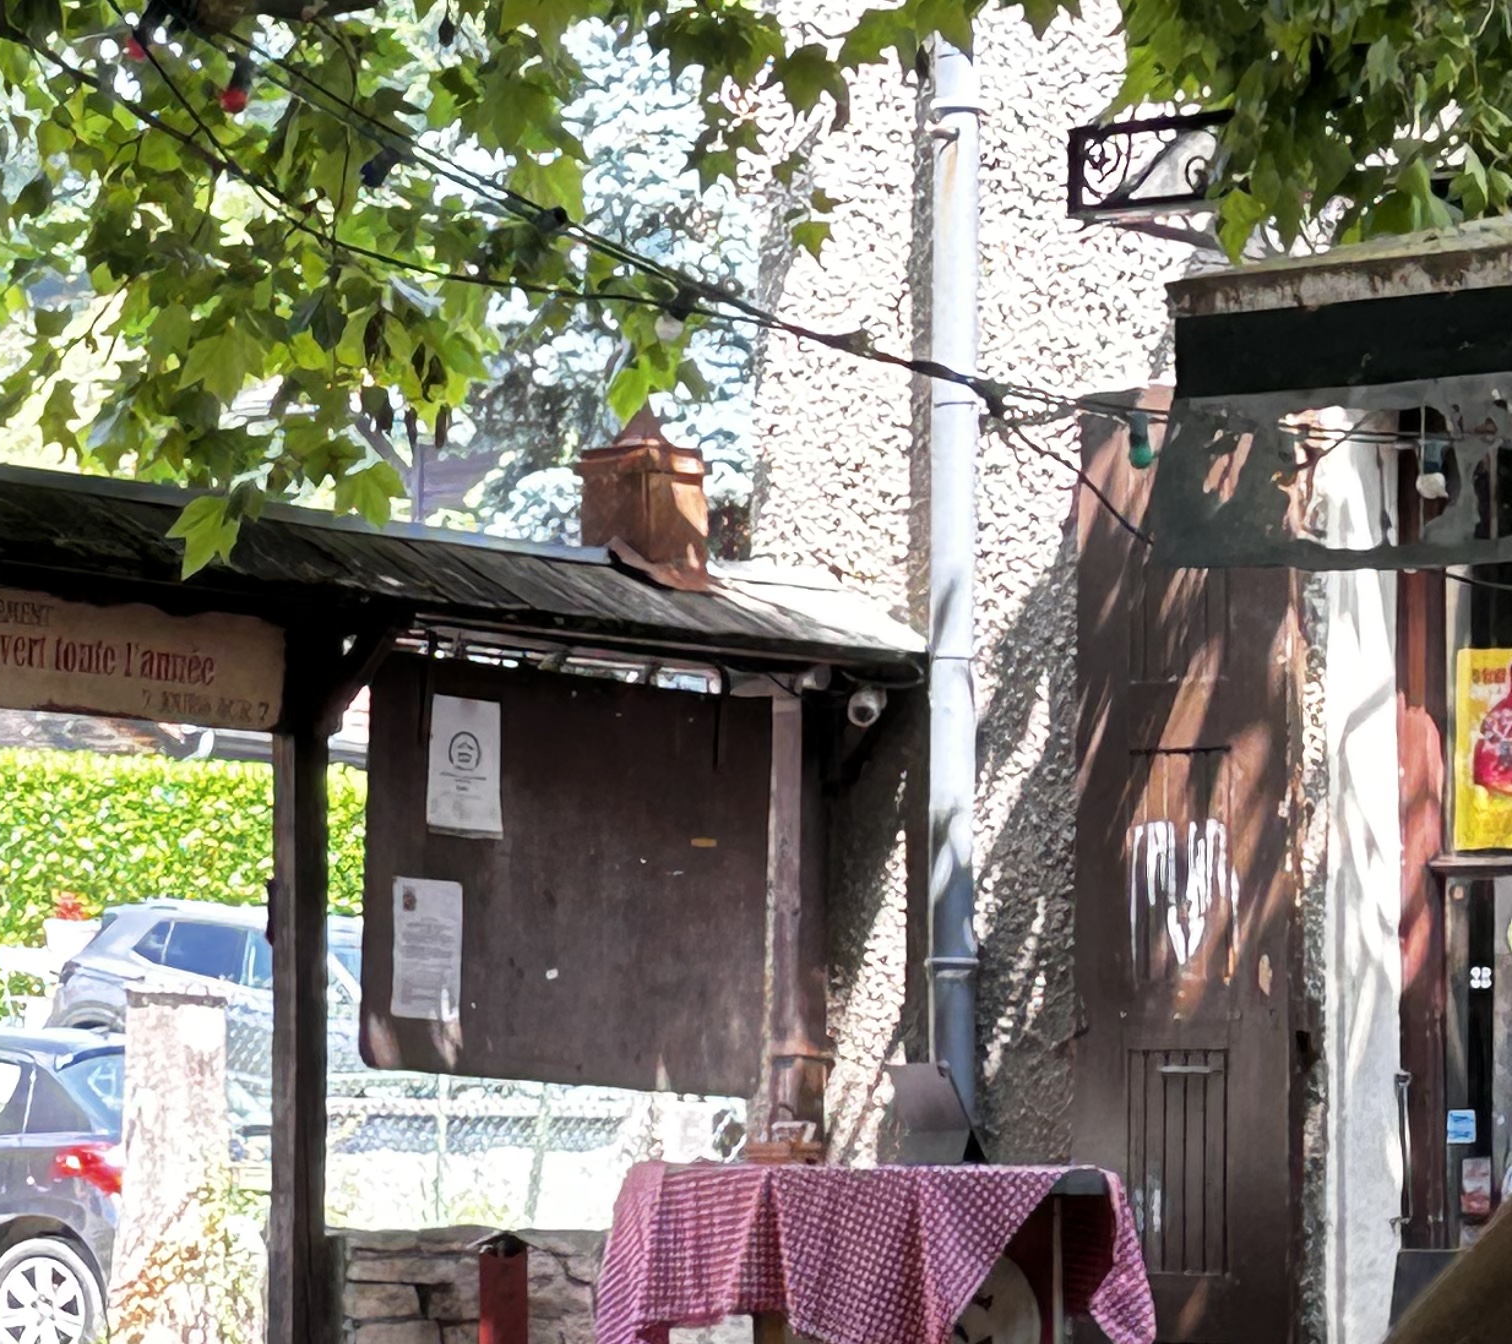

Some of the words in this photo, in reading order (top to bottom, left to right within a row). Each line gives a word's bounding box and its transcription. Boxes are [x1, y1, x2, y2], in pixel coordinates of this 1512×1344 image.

[54, 636, 116, 676] toute
[123, 642, 216, 686] l'année
[258, 701, 270, 722] 7
